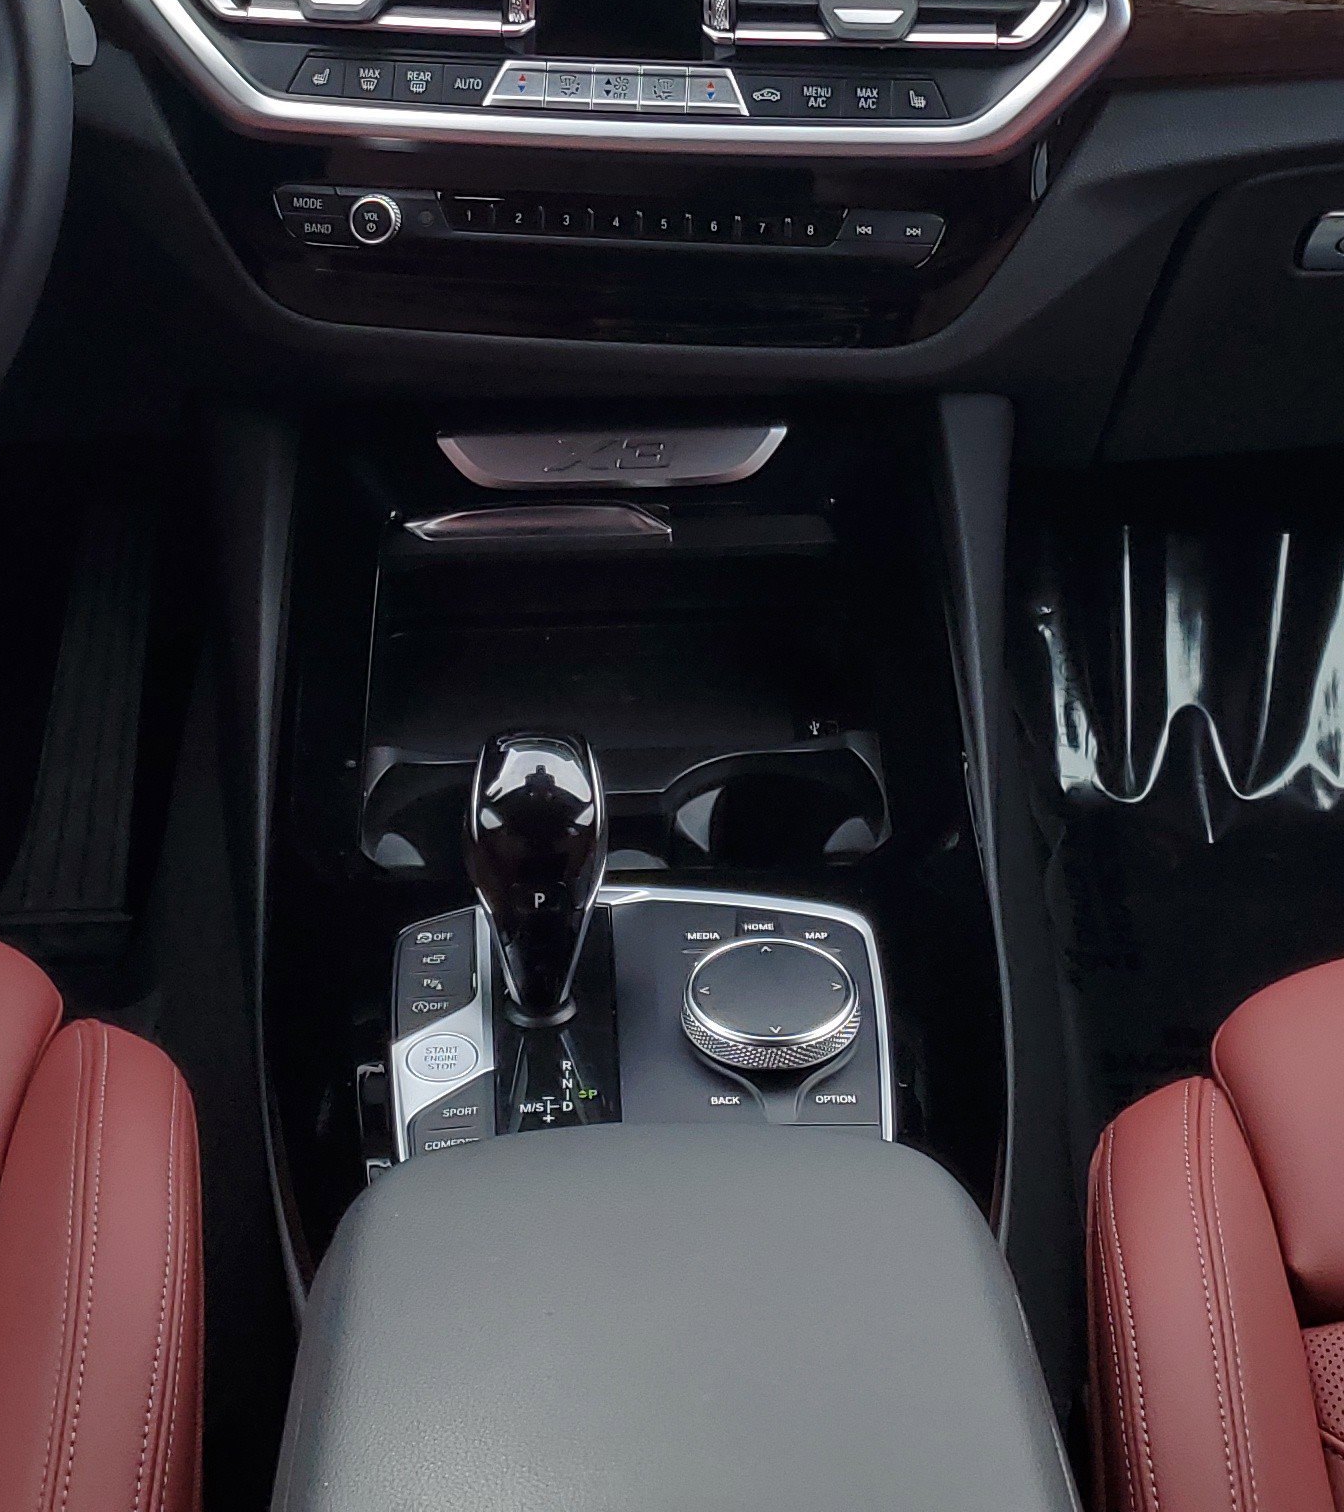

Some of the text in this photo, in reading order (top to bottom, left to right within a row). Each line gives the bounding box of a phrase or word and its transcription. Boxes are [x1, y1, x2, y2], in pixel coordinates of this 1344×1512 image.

[358, 67, 381, 79] MAX
[406, 70, 432, 83] REAR
[454, 77, 483, 90] AUTO
[803, 85, 832, 98] MENU
[856, 87, 879, 99] MAX
[808, 97, 827, 109] A/C
[858, 98, 877, 110] A/C
[292, 196, 324, 210] MODE
[363, 212, 380, 222] VOL
[466, 209, 472, 222] 1
[514, 212, 523, 224] 2
[562, 214, 571, 226] 3
[612, 216, 620, 228] 4
[660, 218, 668, 230] 5
[710, 220, 718, 232] 6
[758, 222, 766, 234] 7
[304, 222, 332, 235] BAND
[806, 224, 815, 236] 8
[534, 892, 546, 909] P
[743, 922, 775, 931] HOME
[433, 932, 453, 941] OFF
[686, 932, 721, 941] MEDIA
[804, 932, 829, 940] MAP
[429, 1001, 449, 1010] OFF
[425, 1045, 459, 1055] START
[423, 1055, 459, 1063] ENGINE
[427, 1062, 457, 1071] STOP
[562, 1060, 573, 1071] R
[562, 1078, 574, 1090] N
[588, 1089, 598, 1100] P
[710, 1096, 741, 1105] BACK
[815, 1094, 857, 1104] OPTION
[442, 1105, 479, 1118] SPORT
[519, 1102, 545, 1114] M/S
[562, 1101, 574, 1112] D
